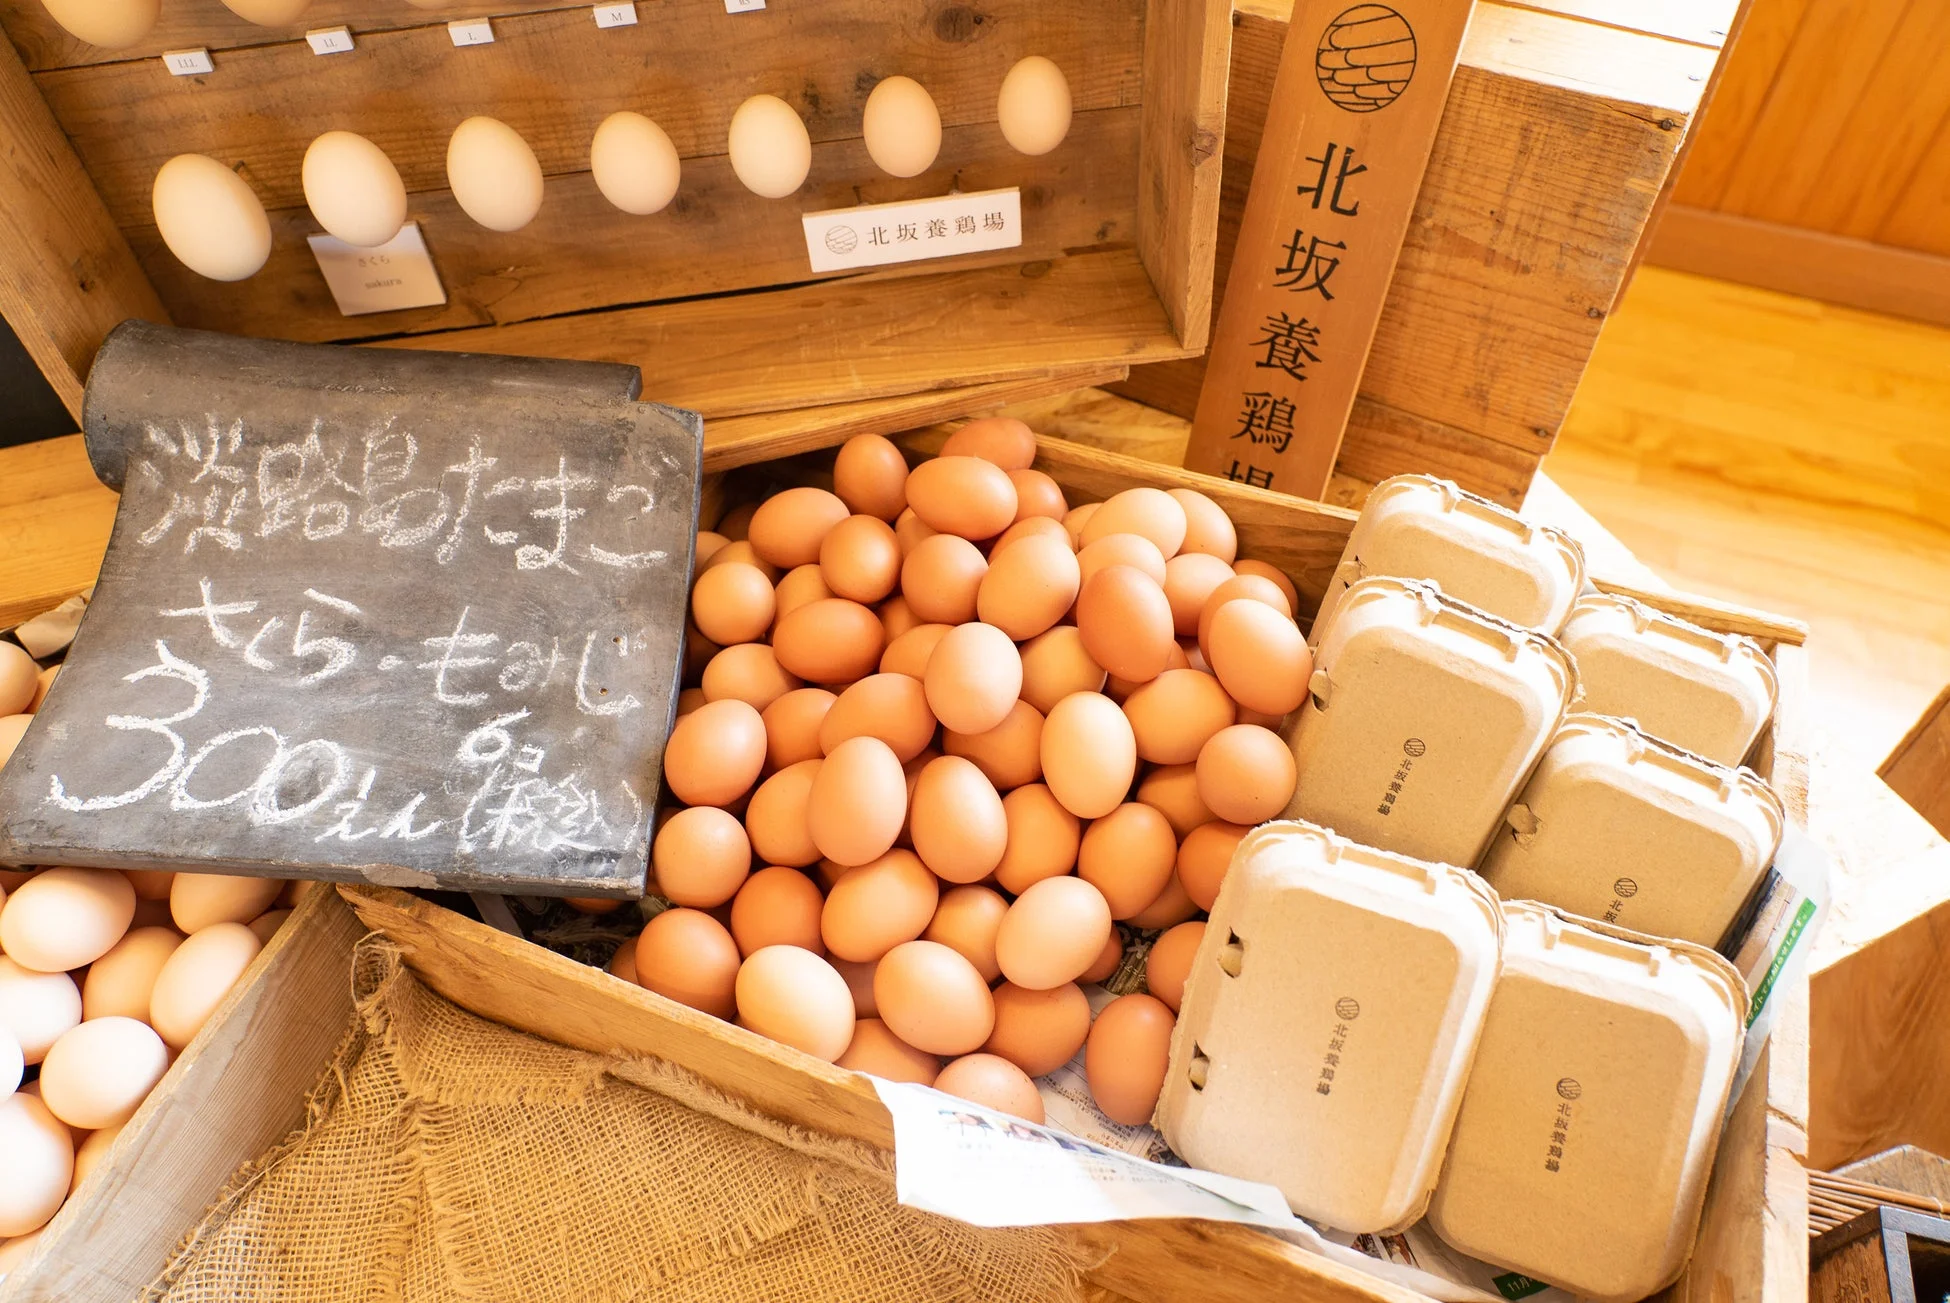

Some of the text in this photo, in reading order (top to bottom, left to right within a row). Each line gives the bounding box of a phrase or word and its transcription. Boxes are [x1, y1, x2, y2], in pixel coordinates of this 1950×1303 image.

[611, 12, 623, 22] M
[467, 32, 477, 41] L
[323, 38, 338, 48] LL
[177, 58, 198, 69] LLL
[867, 211, 1005, 247] 北坂養鶏場
[358, 255, 391, 268] さくら
